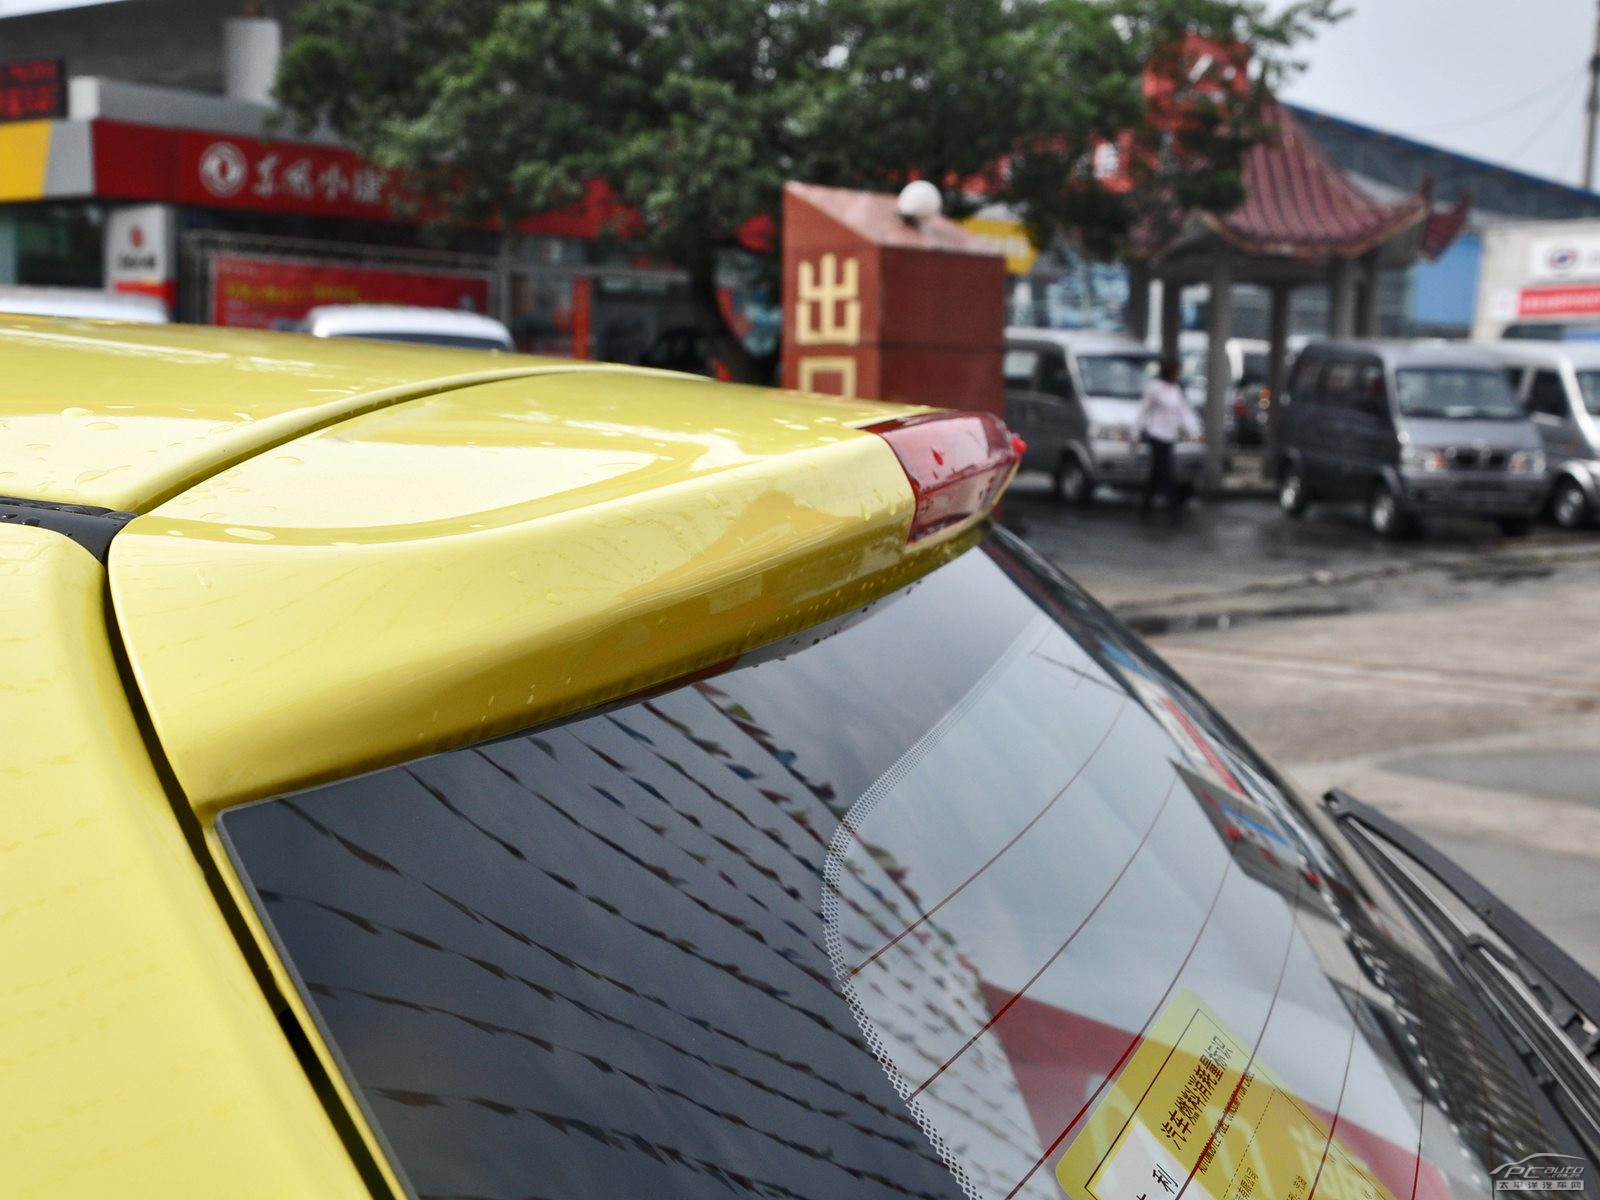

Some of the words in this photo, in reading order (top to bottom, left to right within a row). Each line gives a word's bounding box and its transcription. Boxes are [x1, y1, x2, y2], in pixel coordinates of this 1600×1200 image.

[795, 253, 860, 399] 出口
[1160, 1034, 1233, 1150] 汽车燃料消耗量标识
